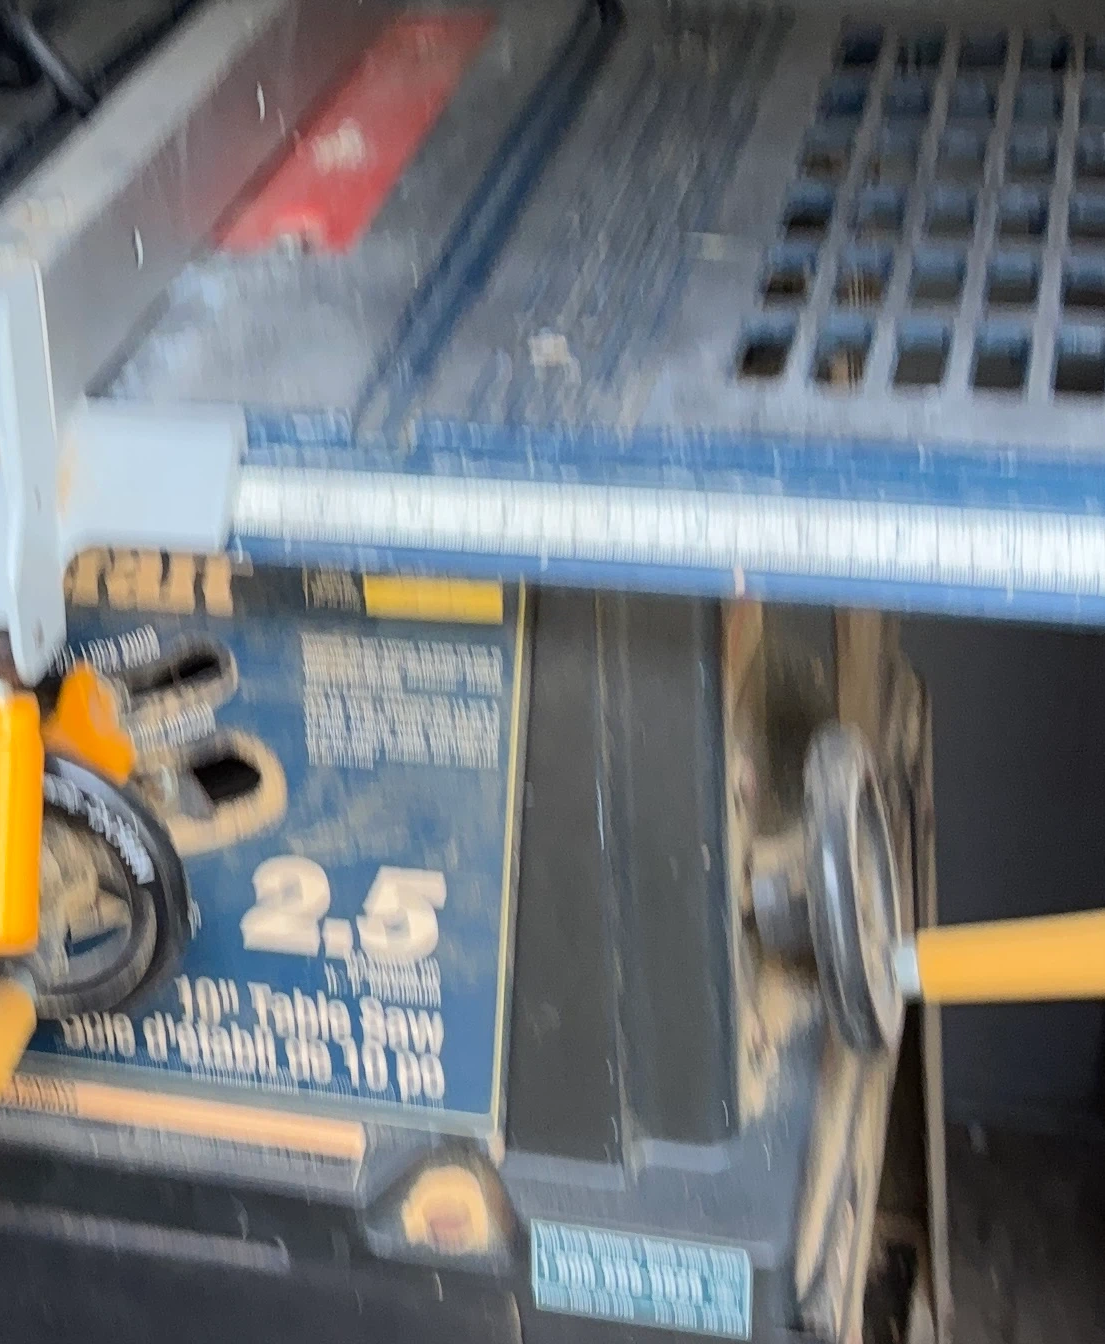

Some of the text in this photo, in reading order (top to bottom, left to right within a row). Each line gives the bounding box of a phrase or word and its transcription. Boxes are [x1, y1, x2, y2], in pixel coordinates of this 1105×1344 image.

[239, 854, 447, 960] 2.5
[175, 974, 444, 1056] 10" Table Saw
